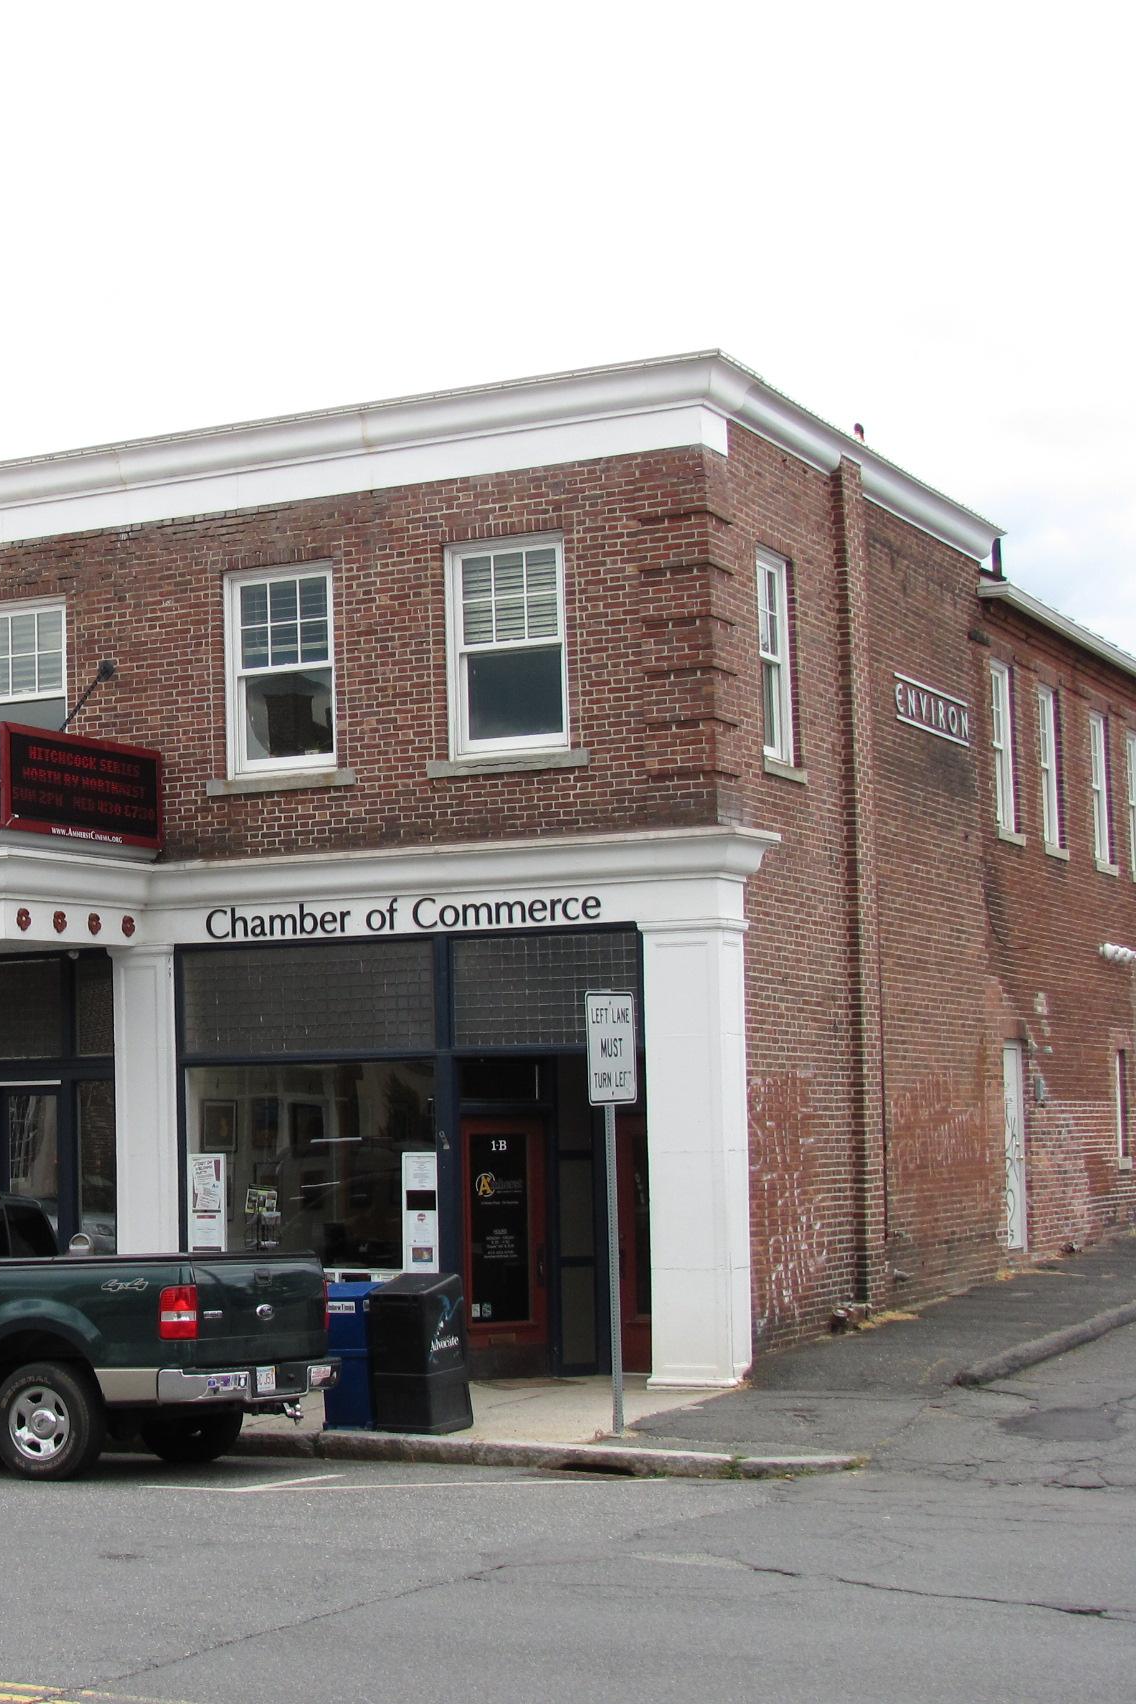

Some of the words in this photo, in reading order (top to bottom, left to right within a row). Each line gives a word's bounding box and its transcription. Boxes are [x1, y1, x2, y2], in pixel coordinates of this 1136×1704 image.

[895, 683, 968, 738] ENVIRON
[28, 747, 96, 769] HITCHCOCK
[100, 759, 140, 778] SERIES
[22, 767, 62, 784] NORTH
[64, 773, 79, 787] BY
[82, 776, 145, 799] NORTHWEST
[205, 903, 351, 939] Chamber
[366, 897, 398, 931] of
[412, 895, 602, 929] Commerce
[591, 1008, 608, 1024] LEFT
[612, 1008, 630, 1023] LANE
[601, 1038, 623, 1058] MUST
[594, 1072, 612, 1088] TURN
[101, 1278, 149, 1292] 4x4
[430, 1335, 459, 1352] Advocate
